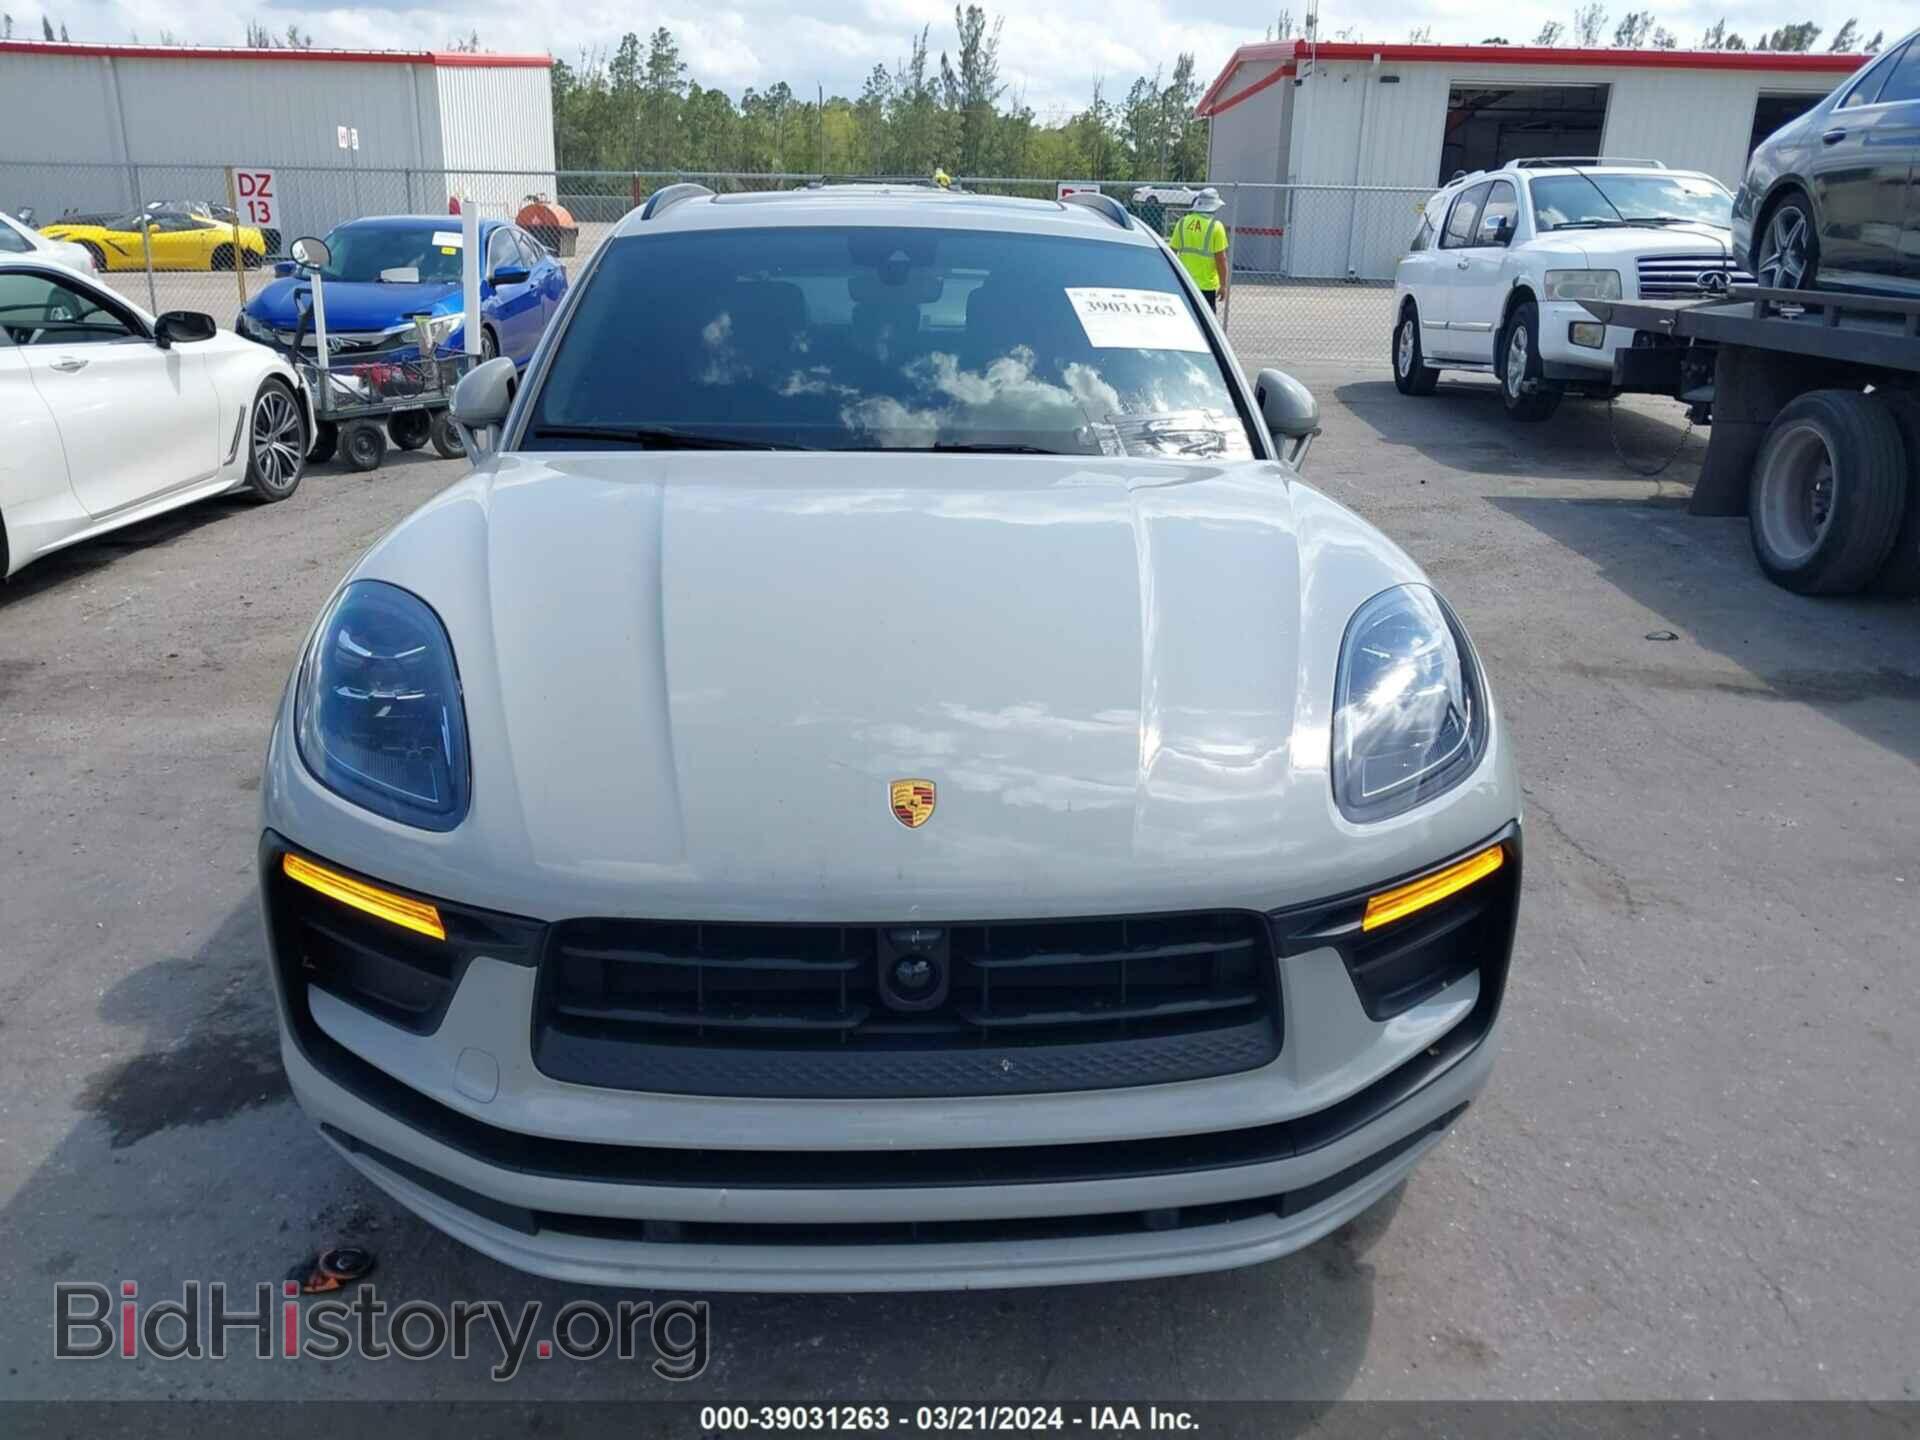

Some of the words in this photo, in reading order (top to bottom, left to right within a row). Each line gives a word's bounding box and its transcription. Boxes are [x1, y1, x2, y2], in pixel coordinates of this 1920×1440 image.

[237, 173, 273, 198] DZ
[247, 200, 271, 224] 13
[1087, 300, 1177, 317] 39031263
